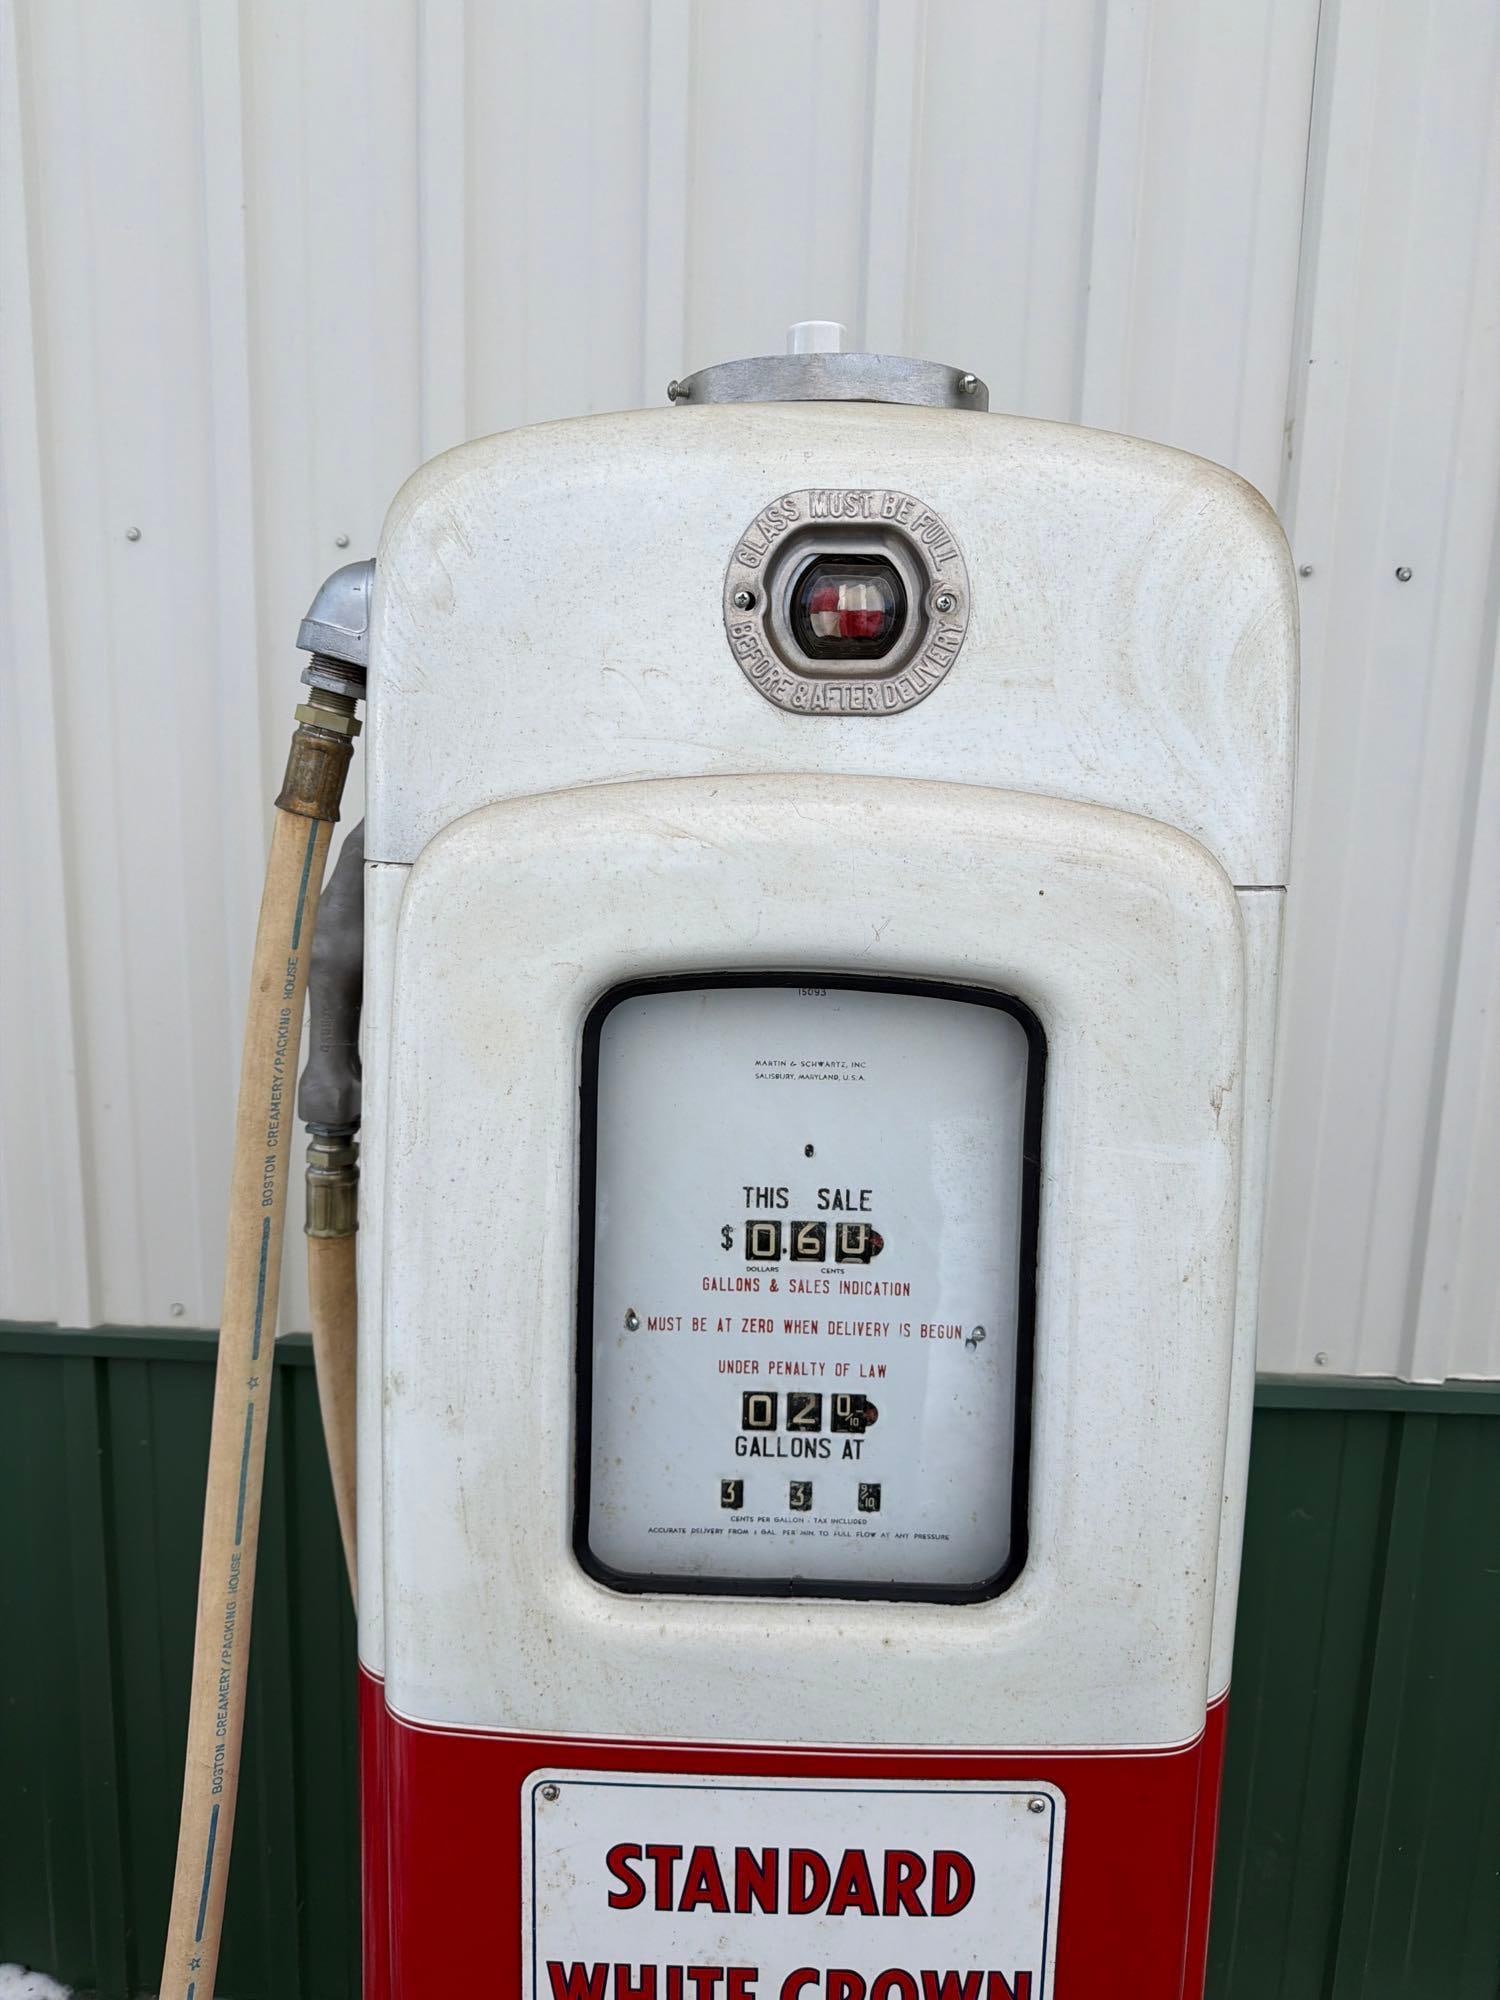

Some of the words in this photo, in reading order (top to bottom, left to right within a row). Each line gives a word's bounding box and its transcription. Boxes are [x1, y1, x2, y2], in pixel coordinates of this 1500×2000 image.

[736, 498, 800, 568] GLASS
[809, 491, 874, 518] MUST
[880, 492, 916, 525] BE
[910, 510, 959, 571] FULL
[730, 621, 794, 703] BEFORE
[793, 684, 807, 709] &
[809, 683, 879, 711] AFTER
[882, 620, 964, 710] DELIVERY
[282, 956, 299, 1000] HOUSE
[267, 1007, 292, 1148] CREAMERY/PACKING
[754, 1072, 796, 1080] SALISBURY,
[798, 1073, 841, 1081] MARYLAND,
[800, 1061, 848, 1069] SCHWARTZ,
[261, 1154, 277, 1207] BOSTON
[742, 1186, 790, 1209] THIS
[817, 1188, 873, 1212] SALE
[720, 1223, 735, 1251] $
[746, 1265, 780, 1273] DOLLARS
[702, 1276, 760, 1292] GALLONS
[769, 1278, 779, 1292] &
[789, 1279, 830, 1294] SALES
[839, 1280, 911, 1297] INDICATION
[647, 1316, 683, 1332] MUST
[692, 1317, 707, 1332] BE
[717, 1318, 732, 1333] AT
[741, 1318, 774, 1333] ZERO
[783, 1319, 818, 1335] WHEN
[828, 1320, 890, 1337] DELIVERY
[899, 1322, 911, 1338] IS
[920, 1323, 963, 1340] BEGUN
[718, 1359, 759, 1375] UNDER
[768, 1360, 826, 1377] PENALTY
[834, 1362, 850, 1377] OF
[859, 1364, 887, 1378] LAW
[735, 1435, 832, 1459] GALLONS
[841, 1438, 865, 1460] AT
[730, 1515, 754, 1523] CENTS
[773, 1516, 805, 1524] GALLON
[690, 1527, 723, 1535] DELIVERY
[833, 1530, 851, 1538] FULL
[913, 1532, 950, 1541] PRESSURE
[227, 1552, 242, 1595] HOUSE
[215, 1602, 238, 1738] CREAMERY/PACKING
[211, 1743, 226, 1796] BOSTON
[605, 1842, 976, 1919] STANDARD
